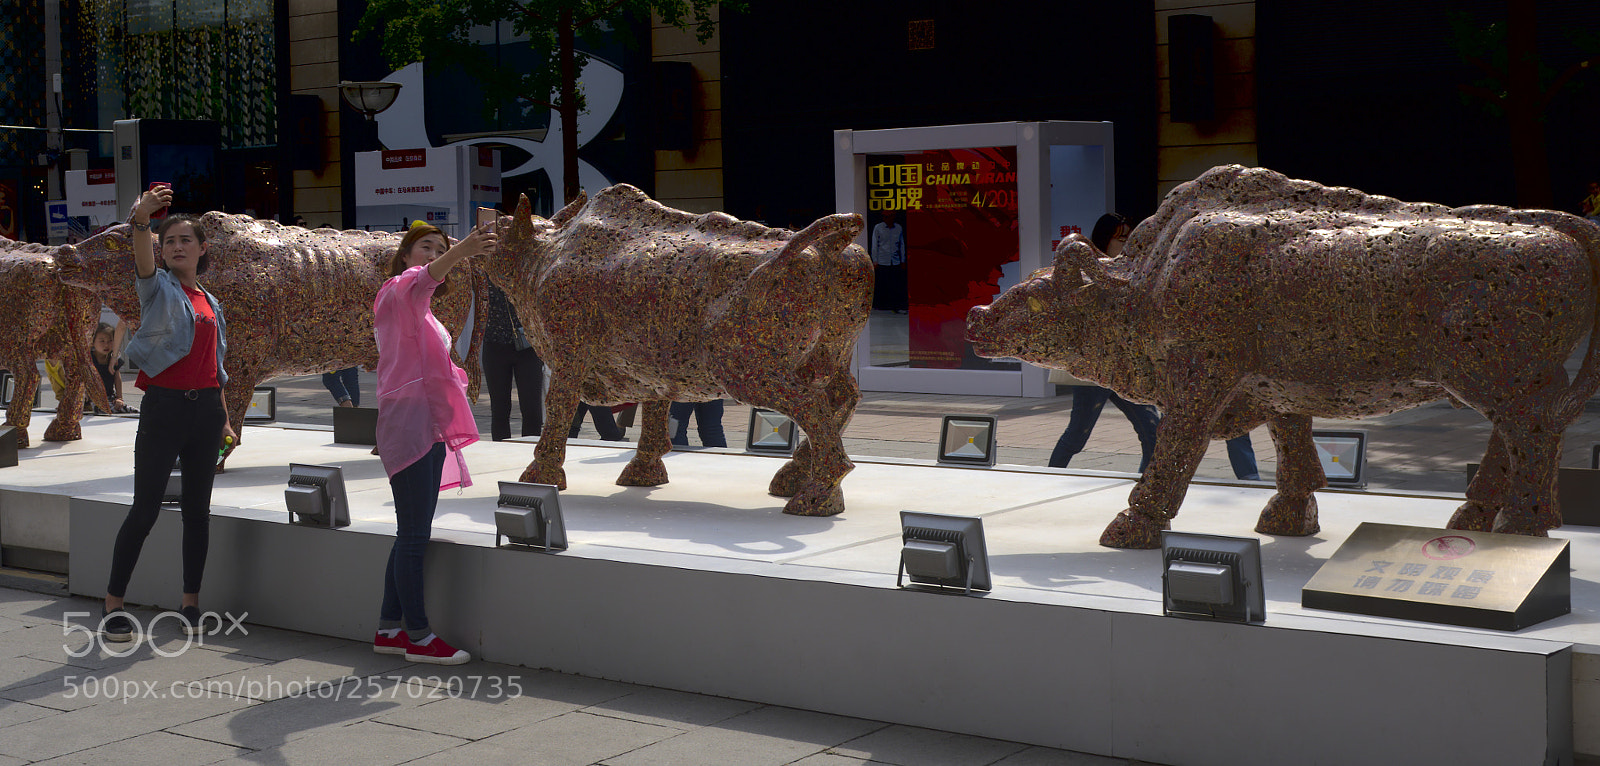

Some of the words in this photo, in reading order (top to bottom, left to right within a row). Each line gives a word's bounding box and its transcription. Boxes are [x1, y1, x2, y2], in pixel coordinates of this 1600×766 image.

[868, 163, 923, 187] 中国
[925, 173, 971, 185] CHINA
[975, 171, 1018, 184] BRAN
[868, 187, 923, 211] 品牌
[971, 189, 1018, 208] 4/201
[1364, 560, 1496, 584] 文明观展
